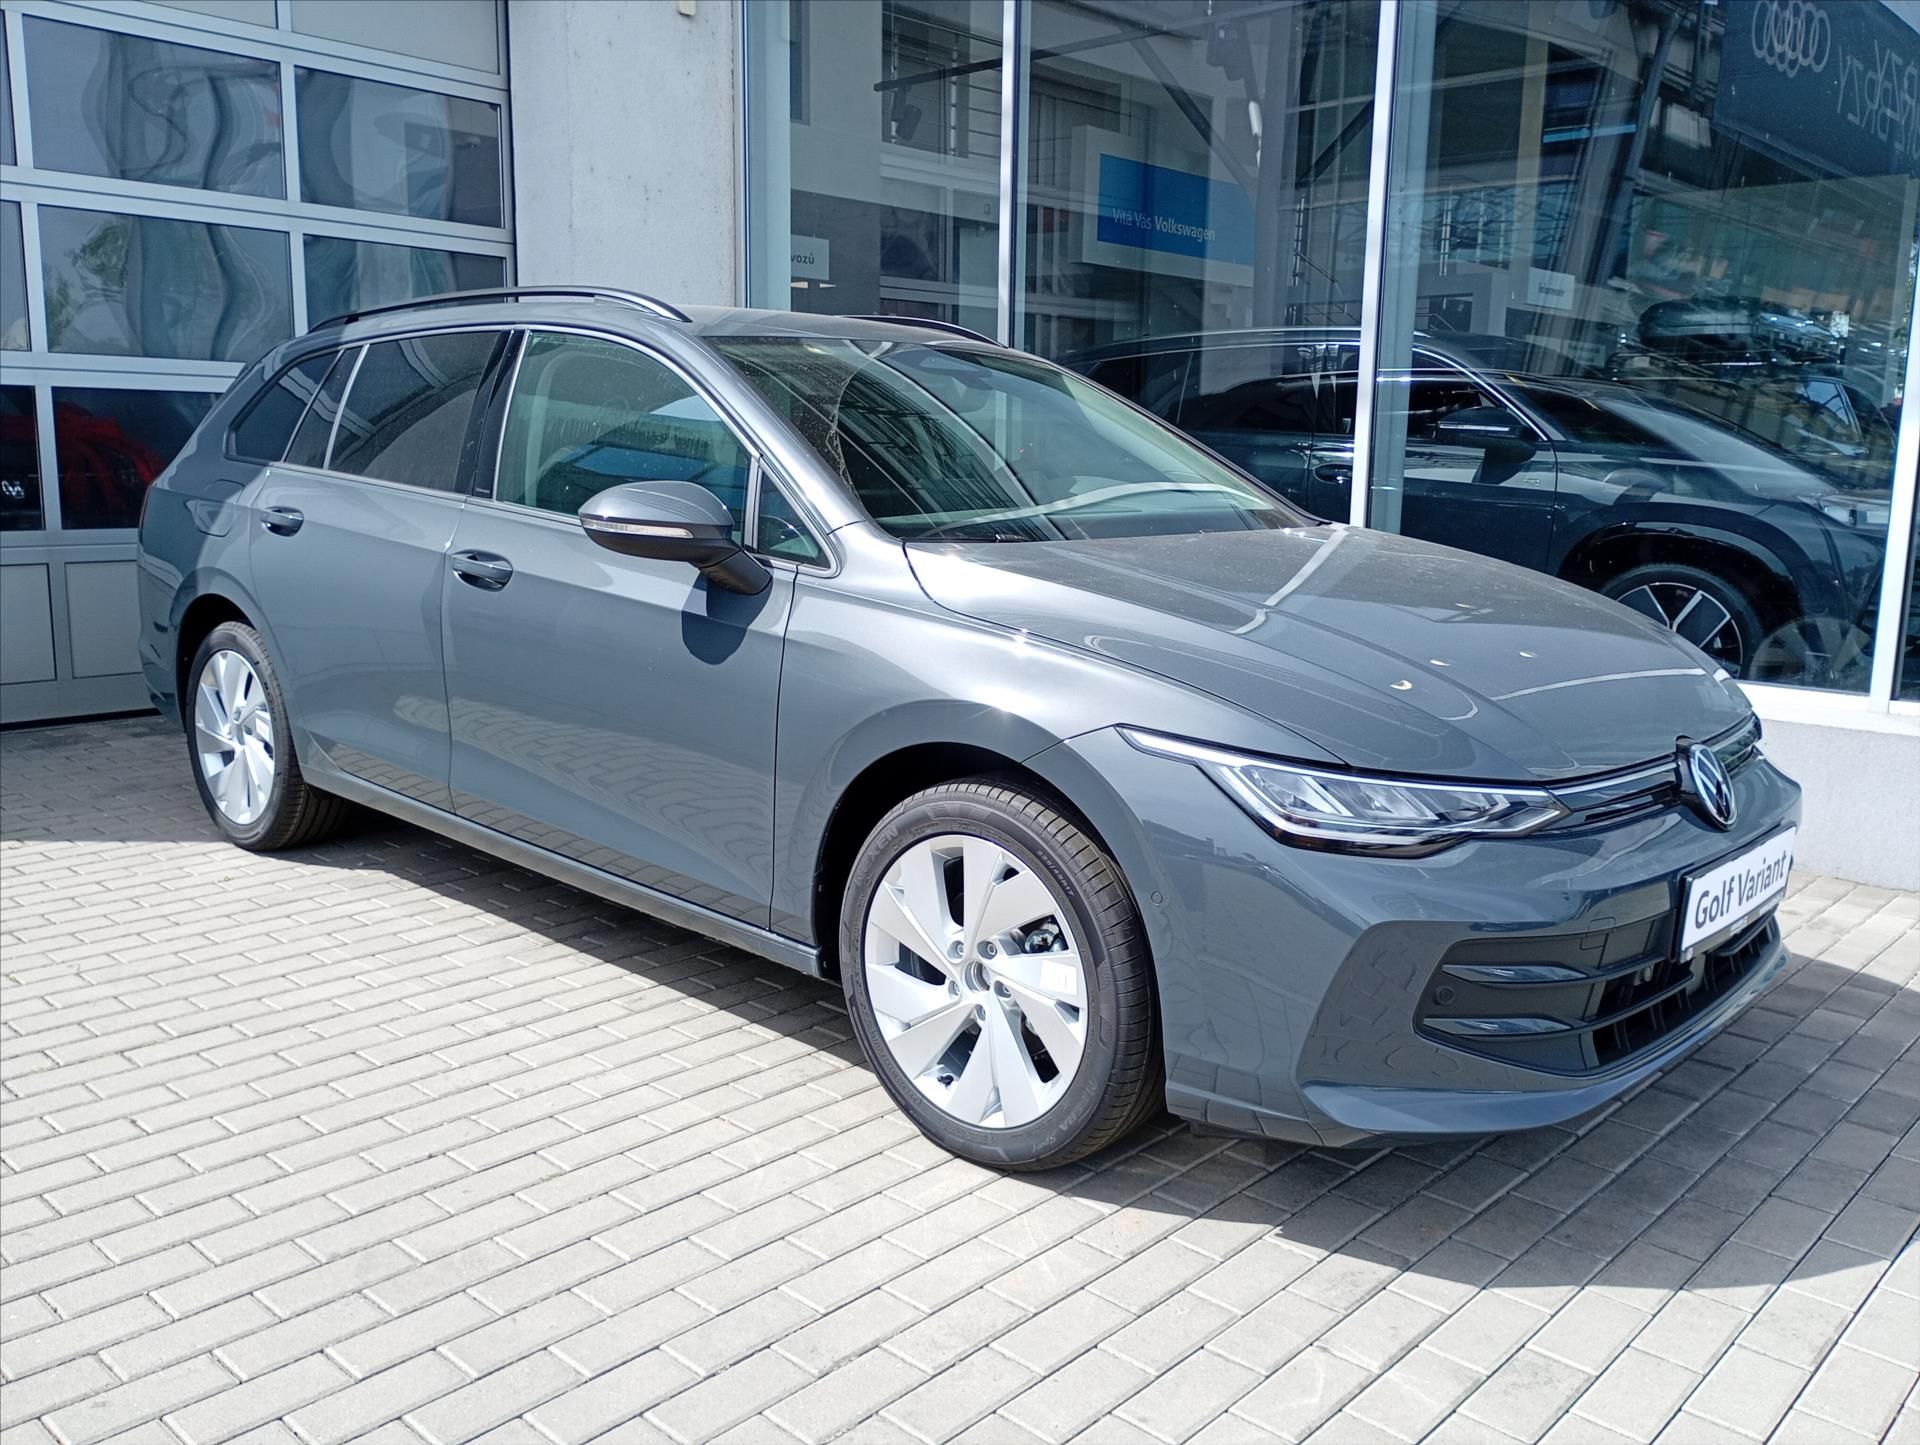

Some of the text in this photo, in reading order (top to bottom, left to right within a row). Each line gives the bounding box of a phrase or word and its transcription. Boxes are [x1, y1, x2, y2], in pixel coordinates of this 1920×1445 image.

[1154, 215, 1216, 243] Volkswagen
[1694, 876, 1735, 930] Golf
[1738, 849, 1788, 907] Variant
